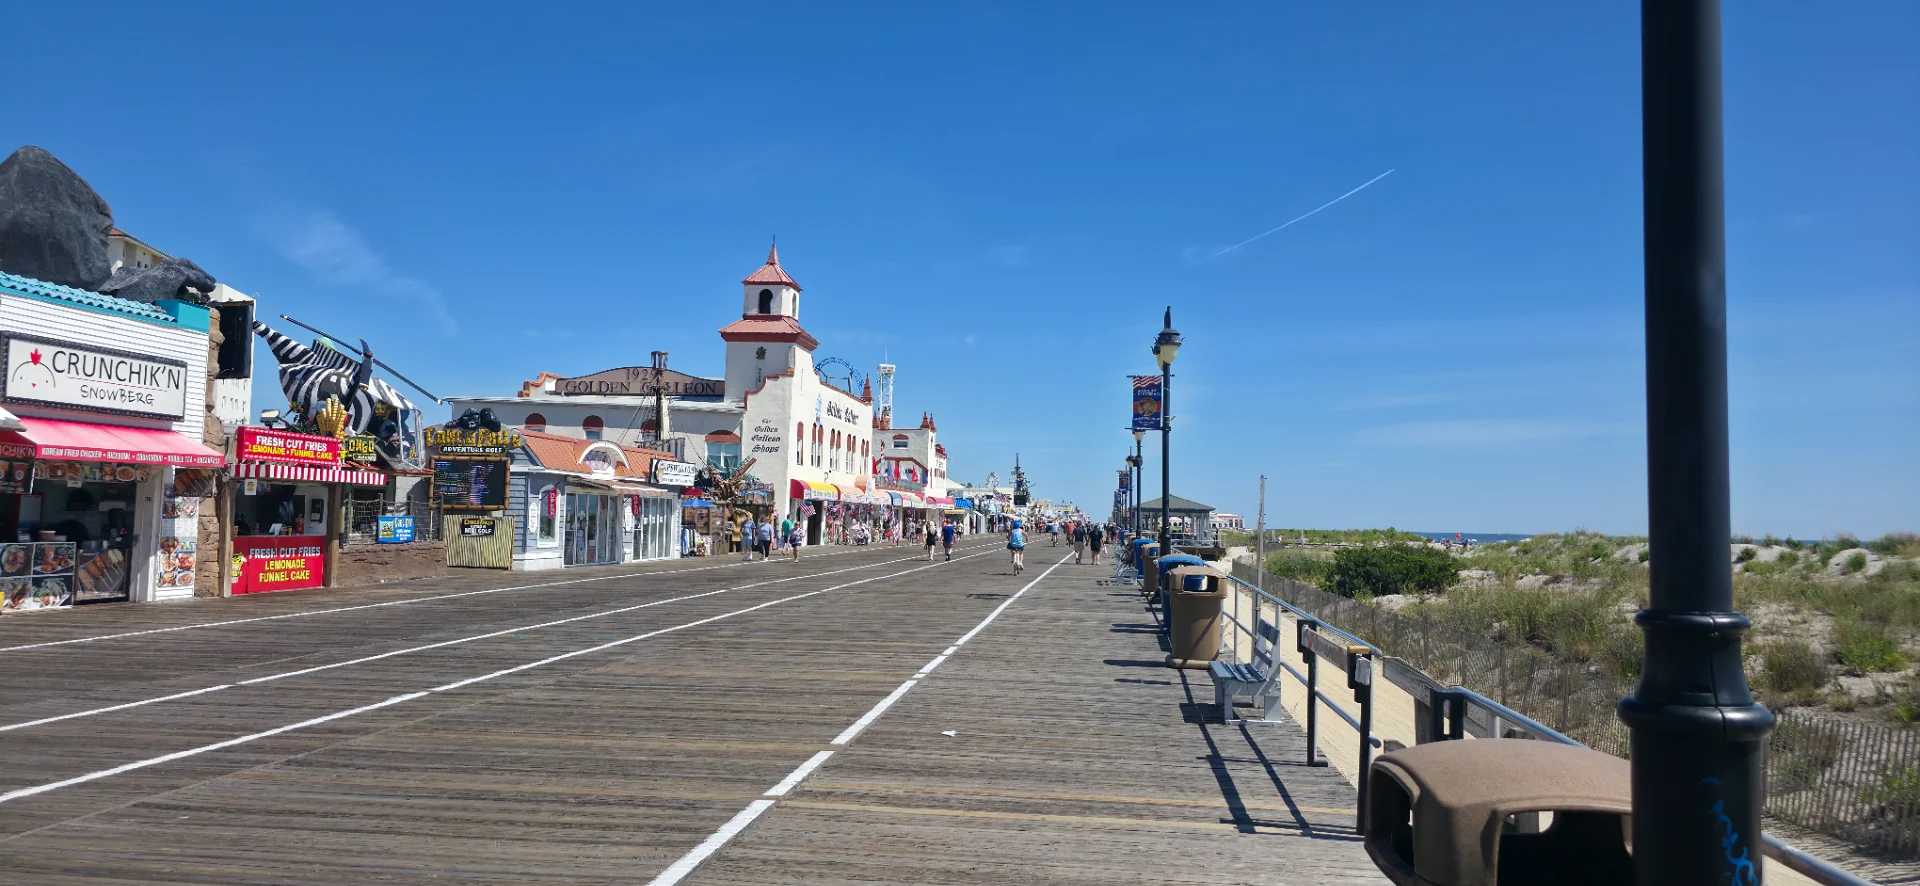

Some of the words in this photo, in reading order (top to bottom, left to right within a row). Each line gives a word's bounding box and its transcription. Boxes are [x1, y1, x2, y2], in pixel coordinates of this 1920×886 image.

[52, 350, 181, 390] CRUNCHIK'N
[565, 380, 631, 393] GOLDEN
[641, 381, 717, 394] GLLEON
[80, 384, 155, 406] SNOWBERG
[256, 435, 284, 447] FRESH
[286, 438, 303, 449] CUT
[304, 441, 328, 452] FRIES
[751, 444, 780, 453] Shops
[41, 447, 64, 456] KOREAN
[64, 448, 79, 457] FRIED
[80, 450, 102, 458] CHICKEN
[247, 443, 286, 455] LEMONADE
[289, 448, 315, 458] FUNNEL
[316, 451, 333, 460] CAKE
[249, 548, 278, 559] FRESH
[279, 547, 296, 558] CUT
[298, 546, 321, 557] FRIES
[265, 559, 306, 570] LEMONADE
[259, 571, 289, 583] FUNNEL
[290, 570, 311, 581] CAKE
